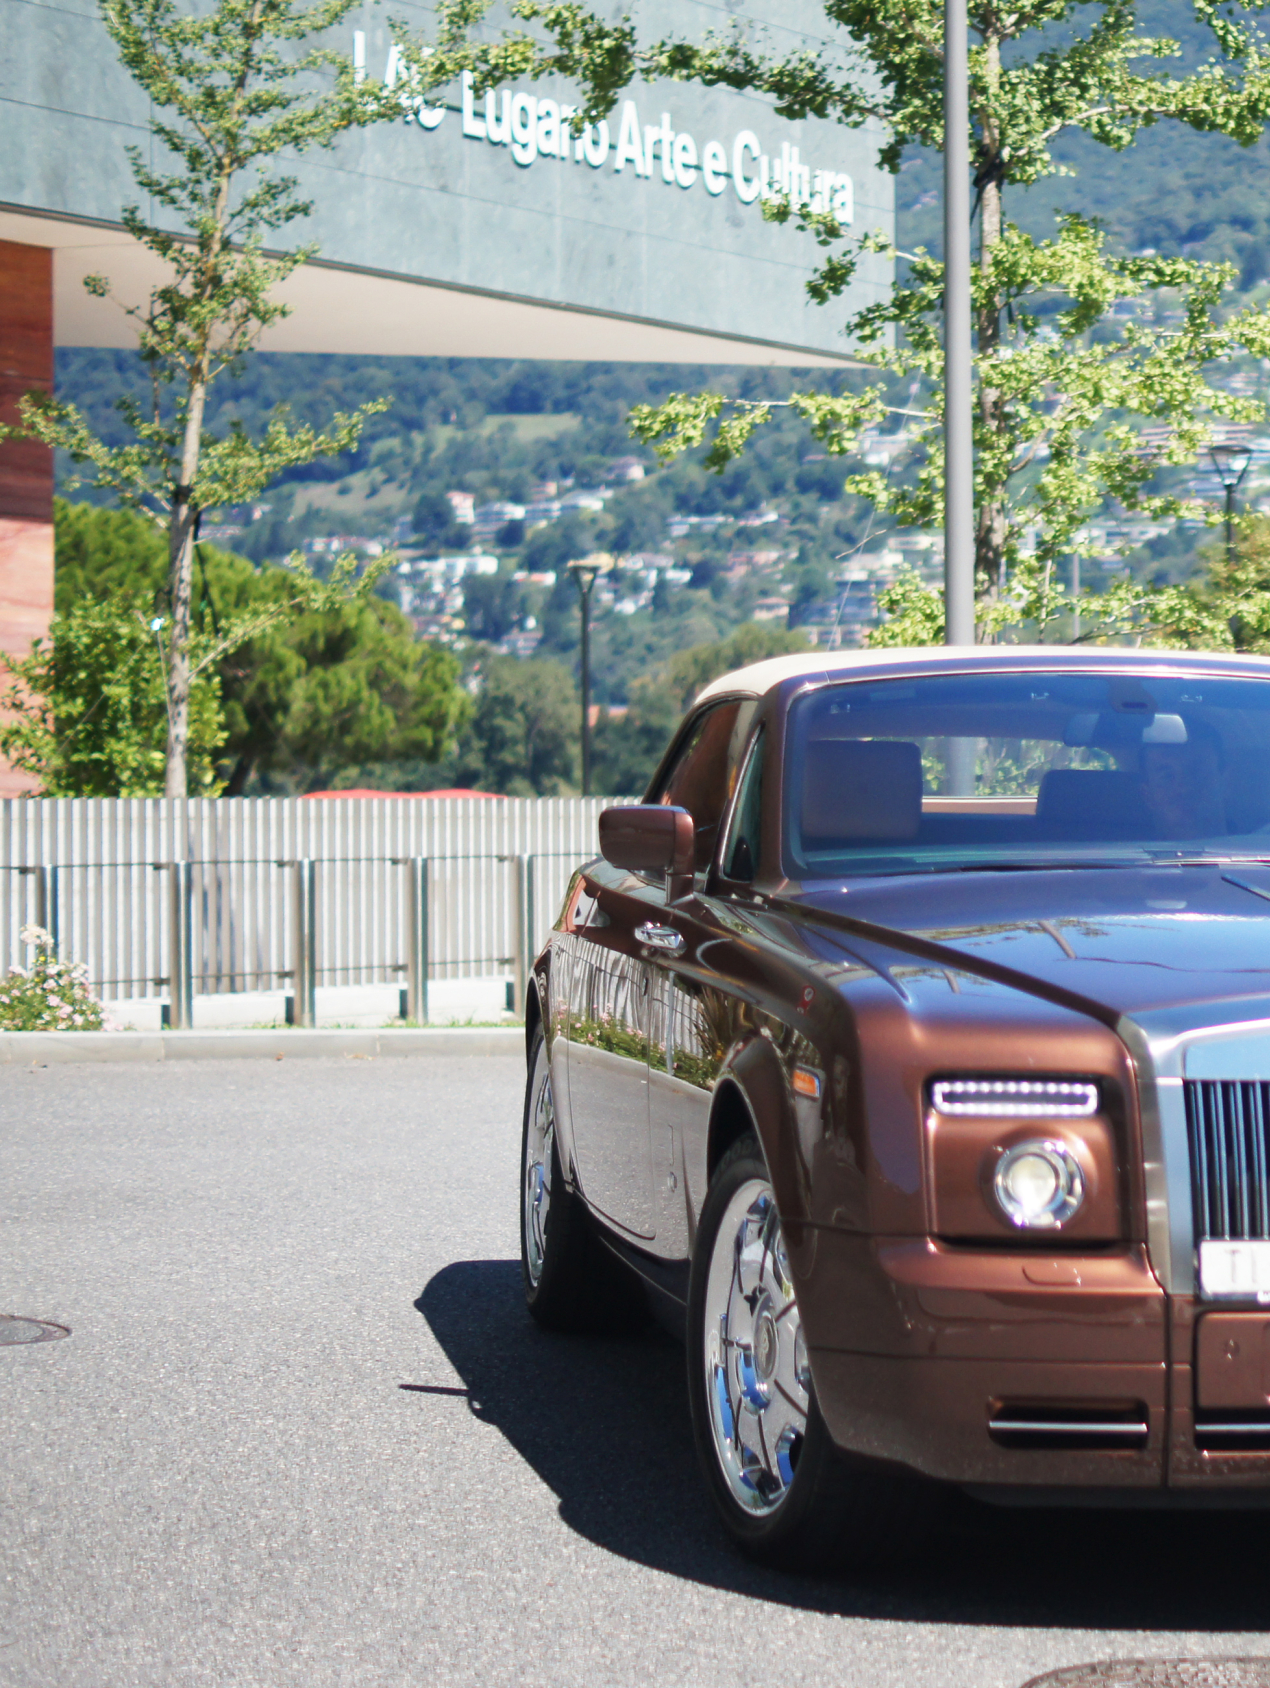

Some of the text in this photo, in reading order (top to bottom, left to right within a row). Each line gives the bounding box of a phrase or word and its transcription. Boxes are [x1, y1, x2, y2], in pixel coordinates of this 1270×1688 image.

[462, 69, 609, 167] Lugano
[614, 99, 698, 189] Arte
[702, 141, 728, 195] e
[732, 129, 855, 226] Cultura
